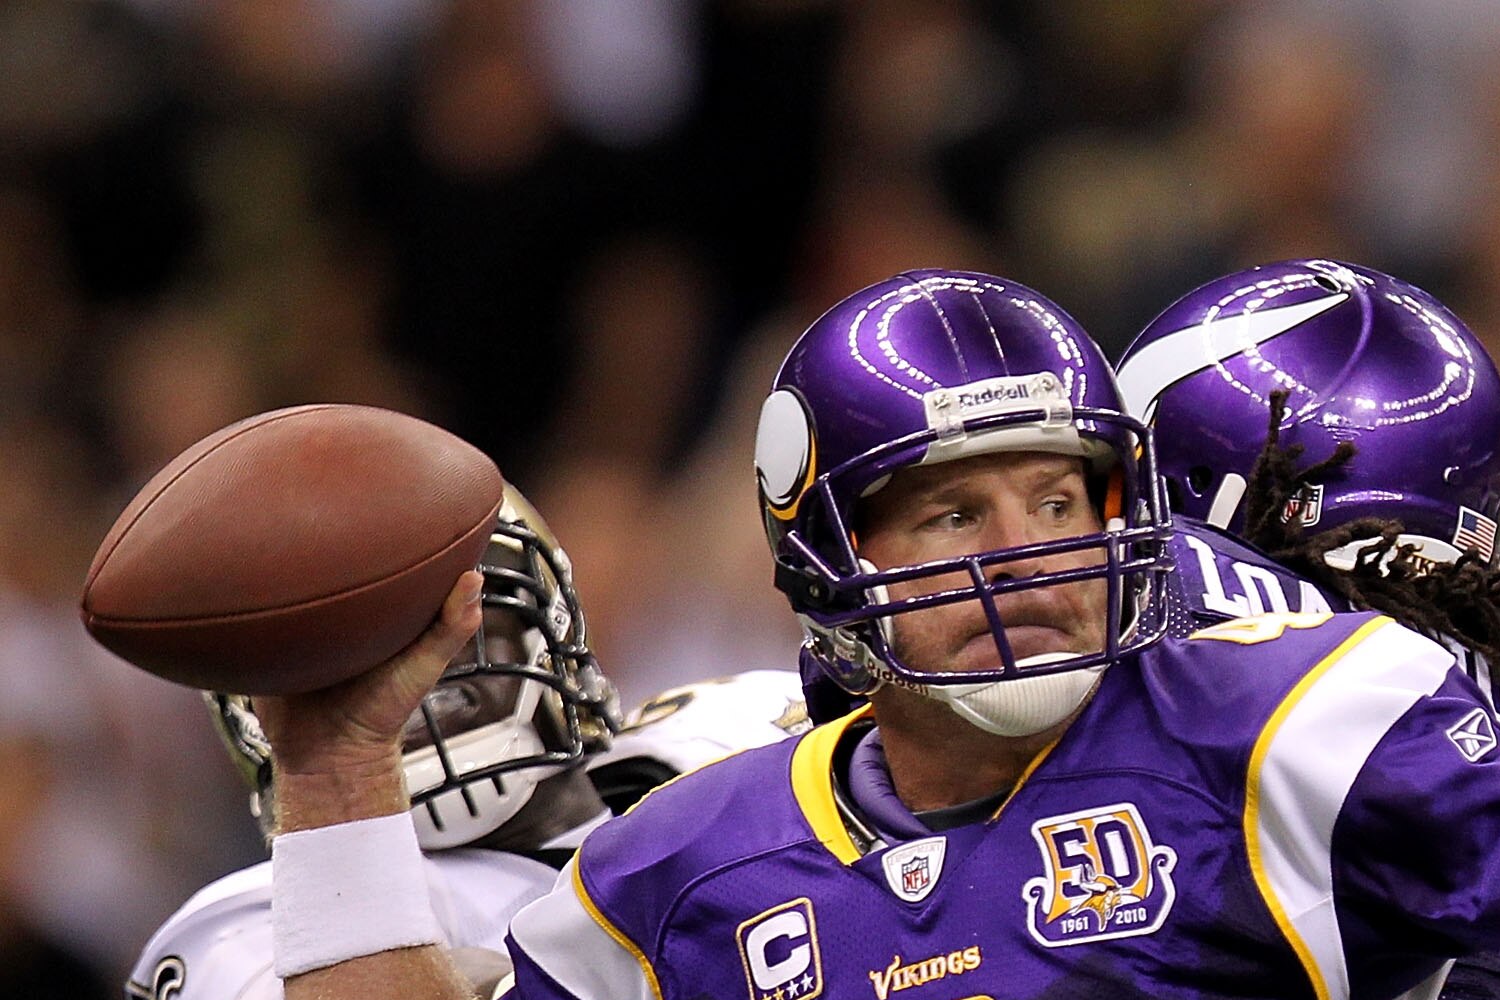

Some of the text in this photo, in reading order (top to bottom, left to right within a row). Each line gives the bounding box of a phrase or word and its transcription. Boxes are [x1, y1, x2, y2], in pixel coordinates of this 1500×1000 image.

[959, 384, 1029, 408] Riddell
[1050, 819, 1142, 900] 50
[904, 869, 929, 890] NFL
[1060, 907, 1147, 934] 1961 2010
[746, 910, 812, 991] C
